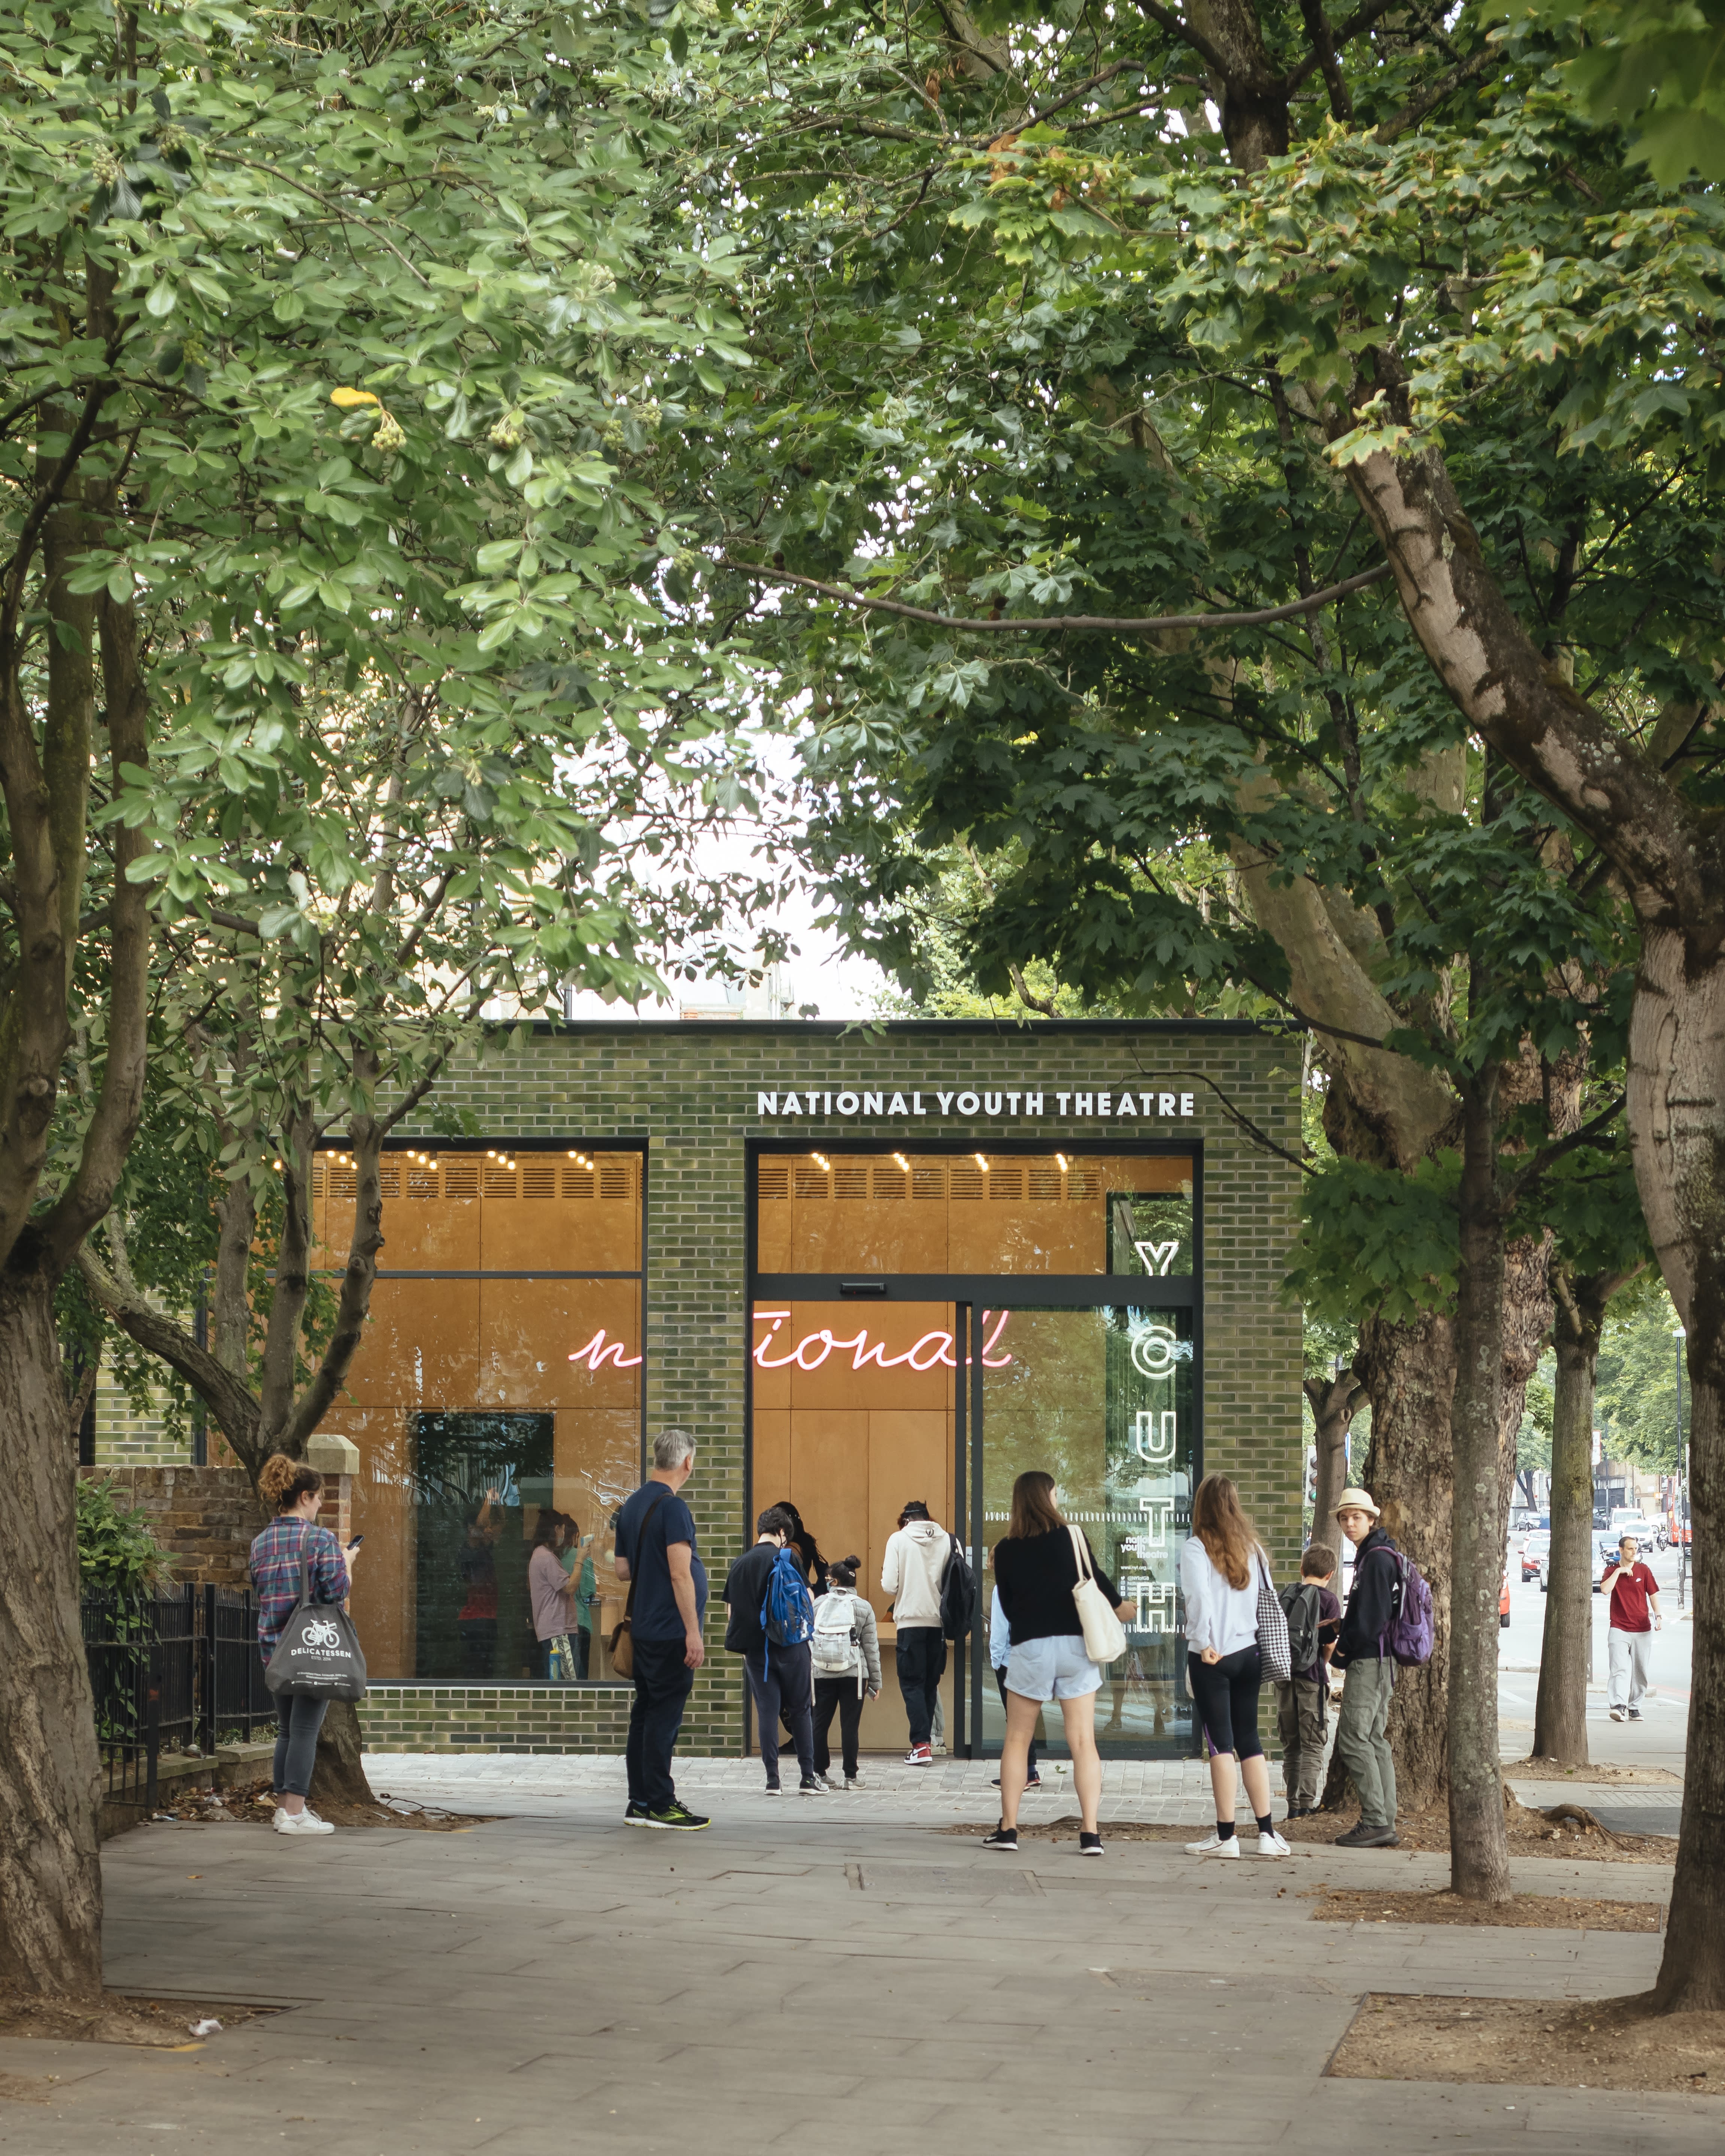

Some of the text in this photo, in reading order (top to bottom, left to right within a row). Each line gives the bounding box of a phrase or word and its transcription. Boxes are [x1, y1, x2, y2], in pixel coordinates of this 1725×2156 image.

[758, 1091, 1194, 1116] NATIONAL YOUTH THEATRE
[1131, 1241, 1179, 1632] YOUTH
[1137, 1550, 1168, 1558] theatre
[291, 1648, 351, 1658] DELICATESSEN
